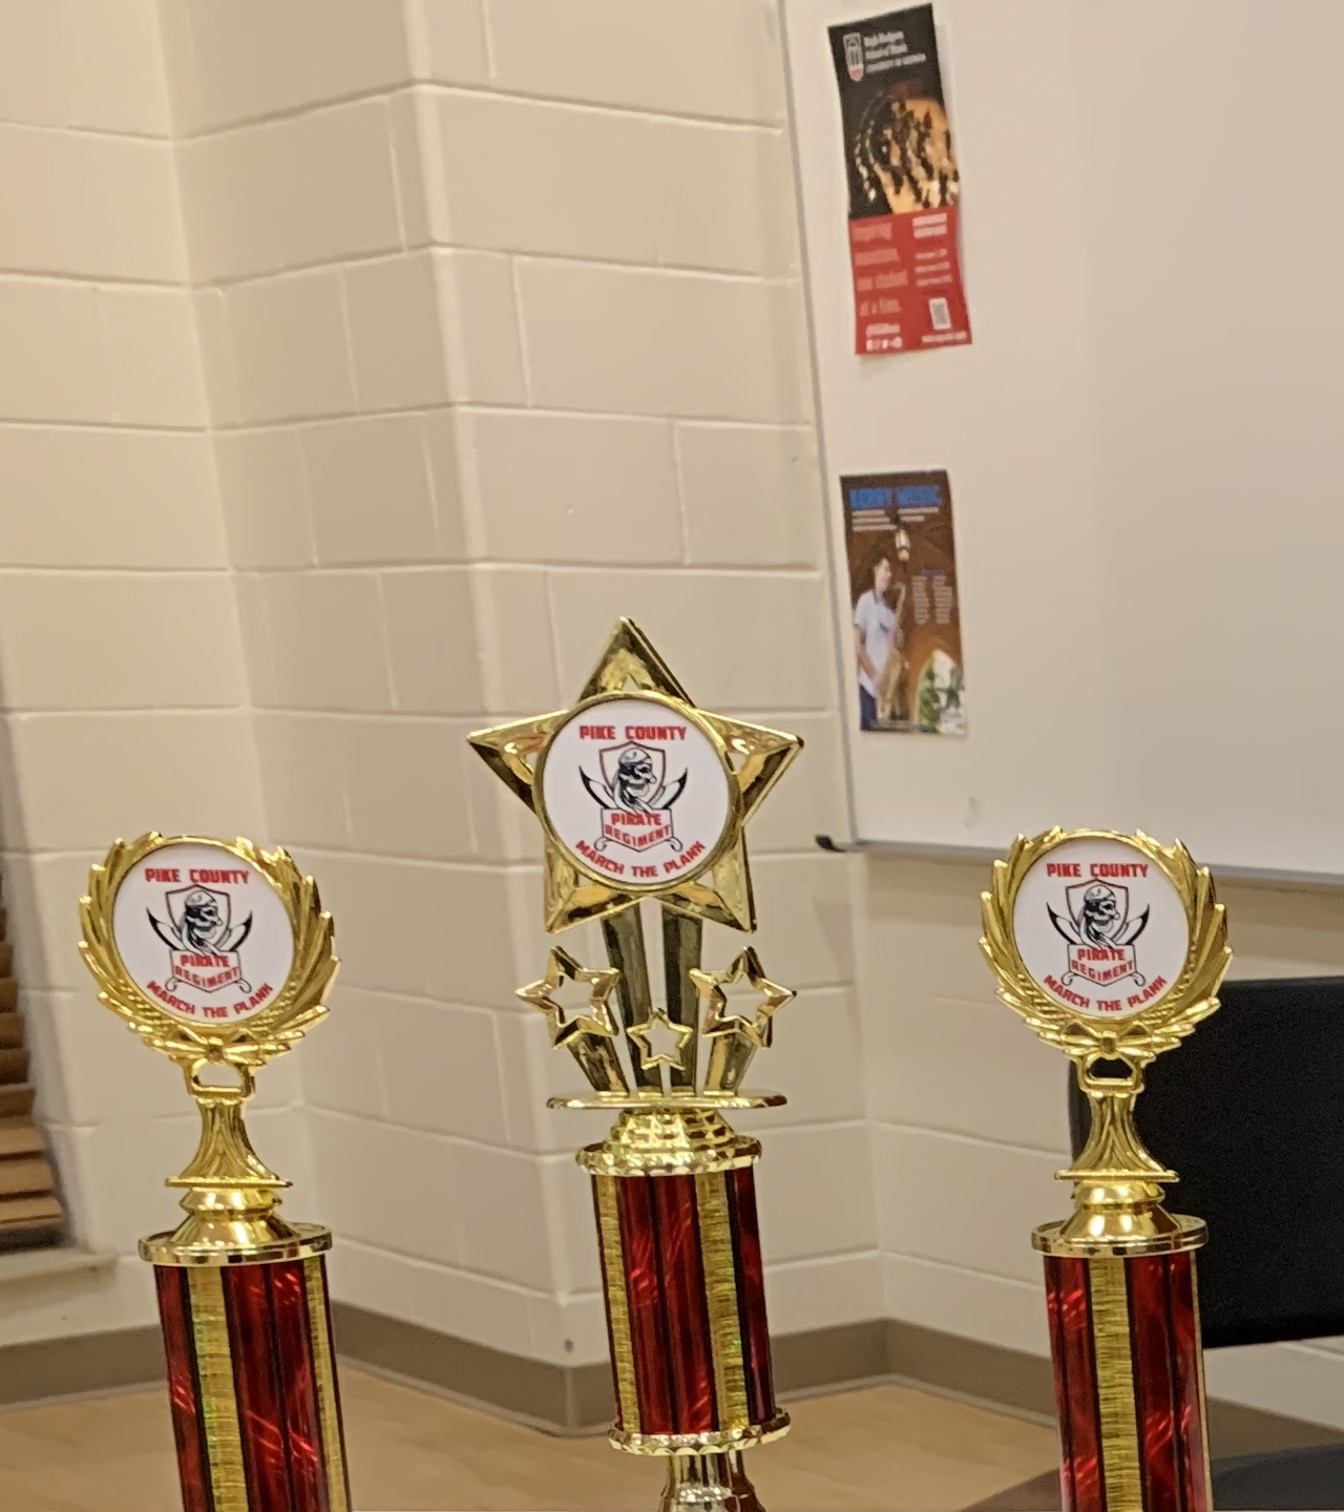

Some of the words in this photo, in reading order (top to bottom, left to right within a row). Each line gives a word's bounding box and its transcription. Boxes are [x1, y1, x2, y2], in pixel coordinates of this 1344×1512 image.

[579, 725, 616, 740] PIKE
[625, 726, 687, 740] COUNTY
[611, 813, 662, 826] PIRATE
[604, 825, 671, 847] REGIMENT
[575, 840, 624, 875] MARCH
[631, 866, 658, 878] THE
[663, 841, 706, 873] PLANK
[145, 868, 180, 883] PIKE
[189, 869, 249, 884] COUNTY
[1047, 863, 1081, 877] PIKE
[1090, 863, 1149, 878] COUNTY
[180, 955, 229, 967] PIRATE
[1077, 949, 1125, 961] PIRATE
[174, 966, 240, 987] REGIMENT
[1071, 960, 1133, 982] REGIMENT
[147, 981, 195, 1015] MARCH
[203, 1006, 228, 1018] THE
[233, 983, 274, 1015] PLANK
[1043, 975, 1089, 1009] MARCH
[1097, 1000, 1122, 1011] THE
[1127, 976, 1168, 1008] PLANK
